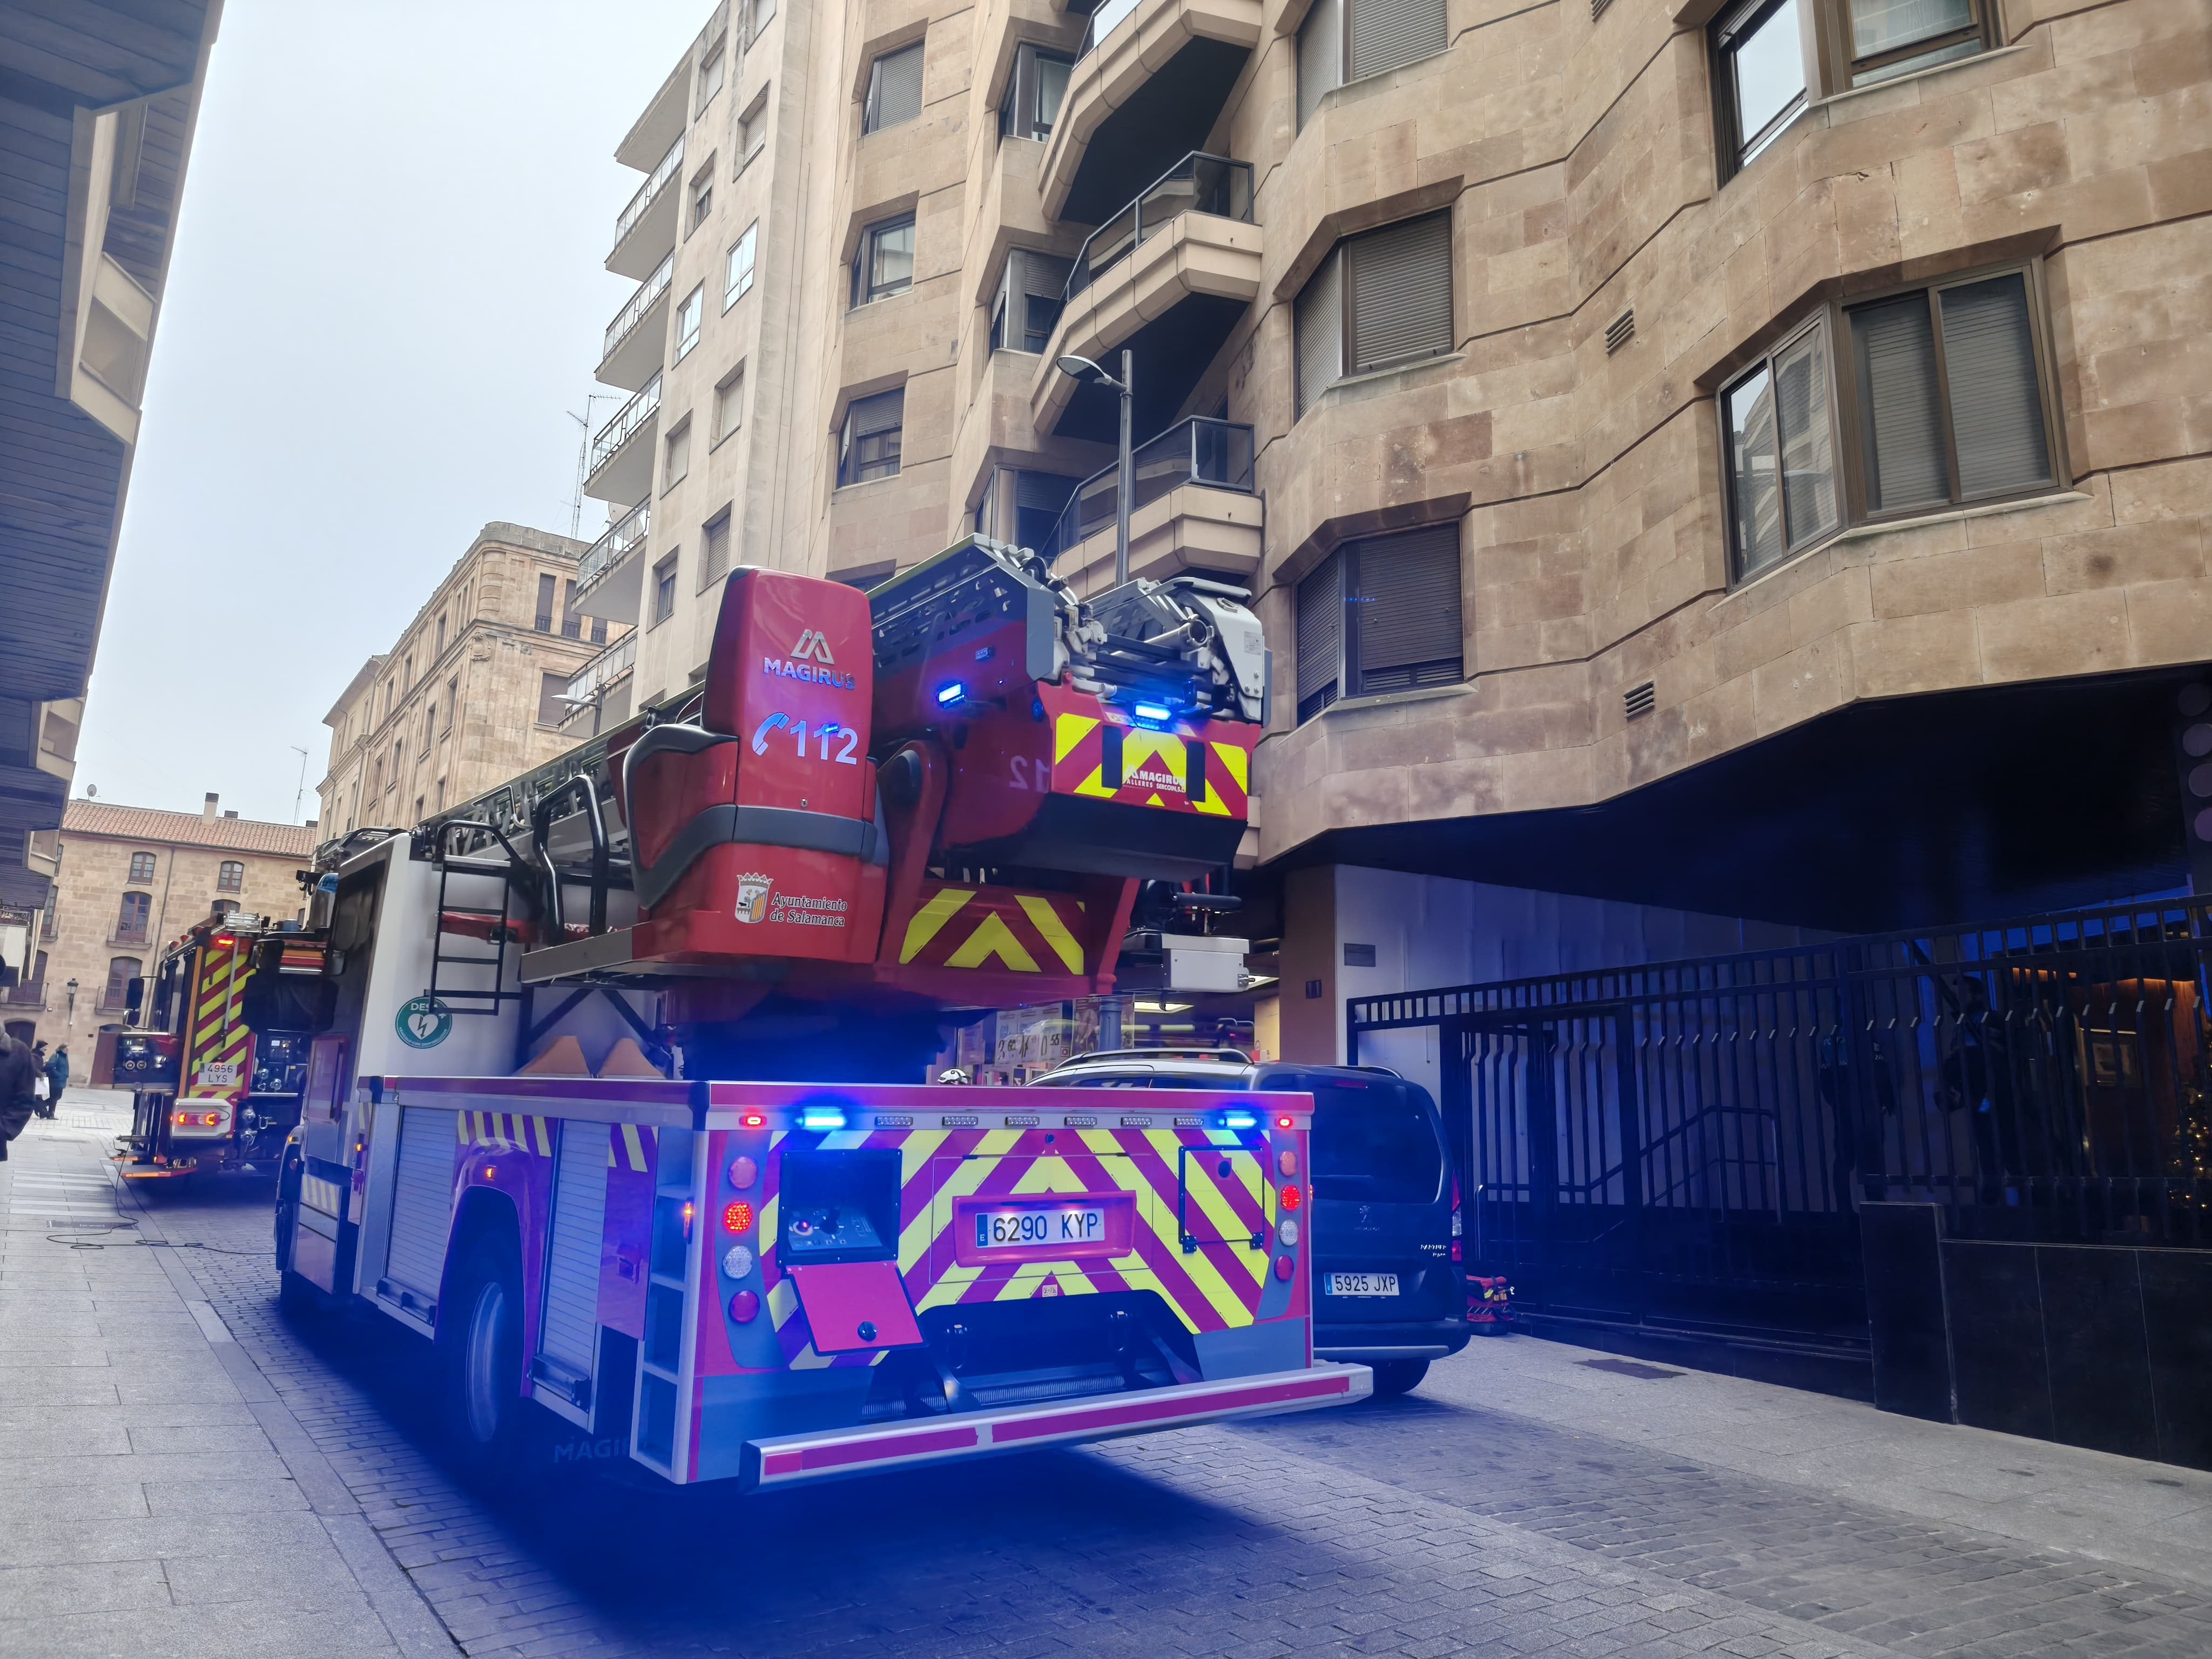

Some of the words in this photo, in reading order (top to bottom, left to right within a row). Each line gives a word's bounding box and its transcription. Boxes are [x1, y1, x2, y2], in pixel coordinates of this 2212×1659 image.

[764, 657, 856, 690] MAGIRUS
[790, 720, 858, 765] 112
[1123, 778, 1153, 788] ALLERES
[1139, 771, 1185, 786] MAGIRUS
[771, 892, 848, 912] Ayuntamiento
[770, 909, 785, 922] de
[787, 910, 845, 927] Salamanca
[207, 1064, 233, 1073] 4956
[208, 1074, 227, 1083] LYS
[993, 1215, 1047, 1242] 6290
[1062, 1213, 1098, 1239] KYP
[1335, 1276, 1369, 1292] 5925
[1374, 1276, 1396, 1292] JXP
[553, 1437, 630, 1463] MAGI
